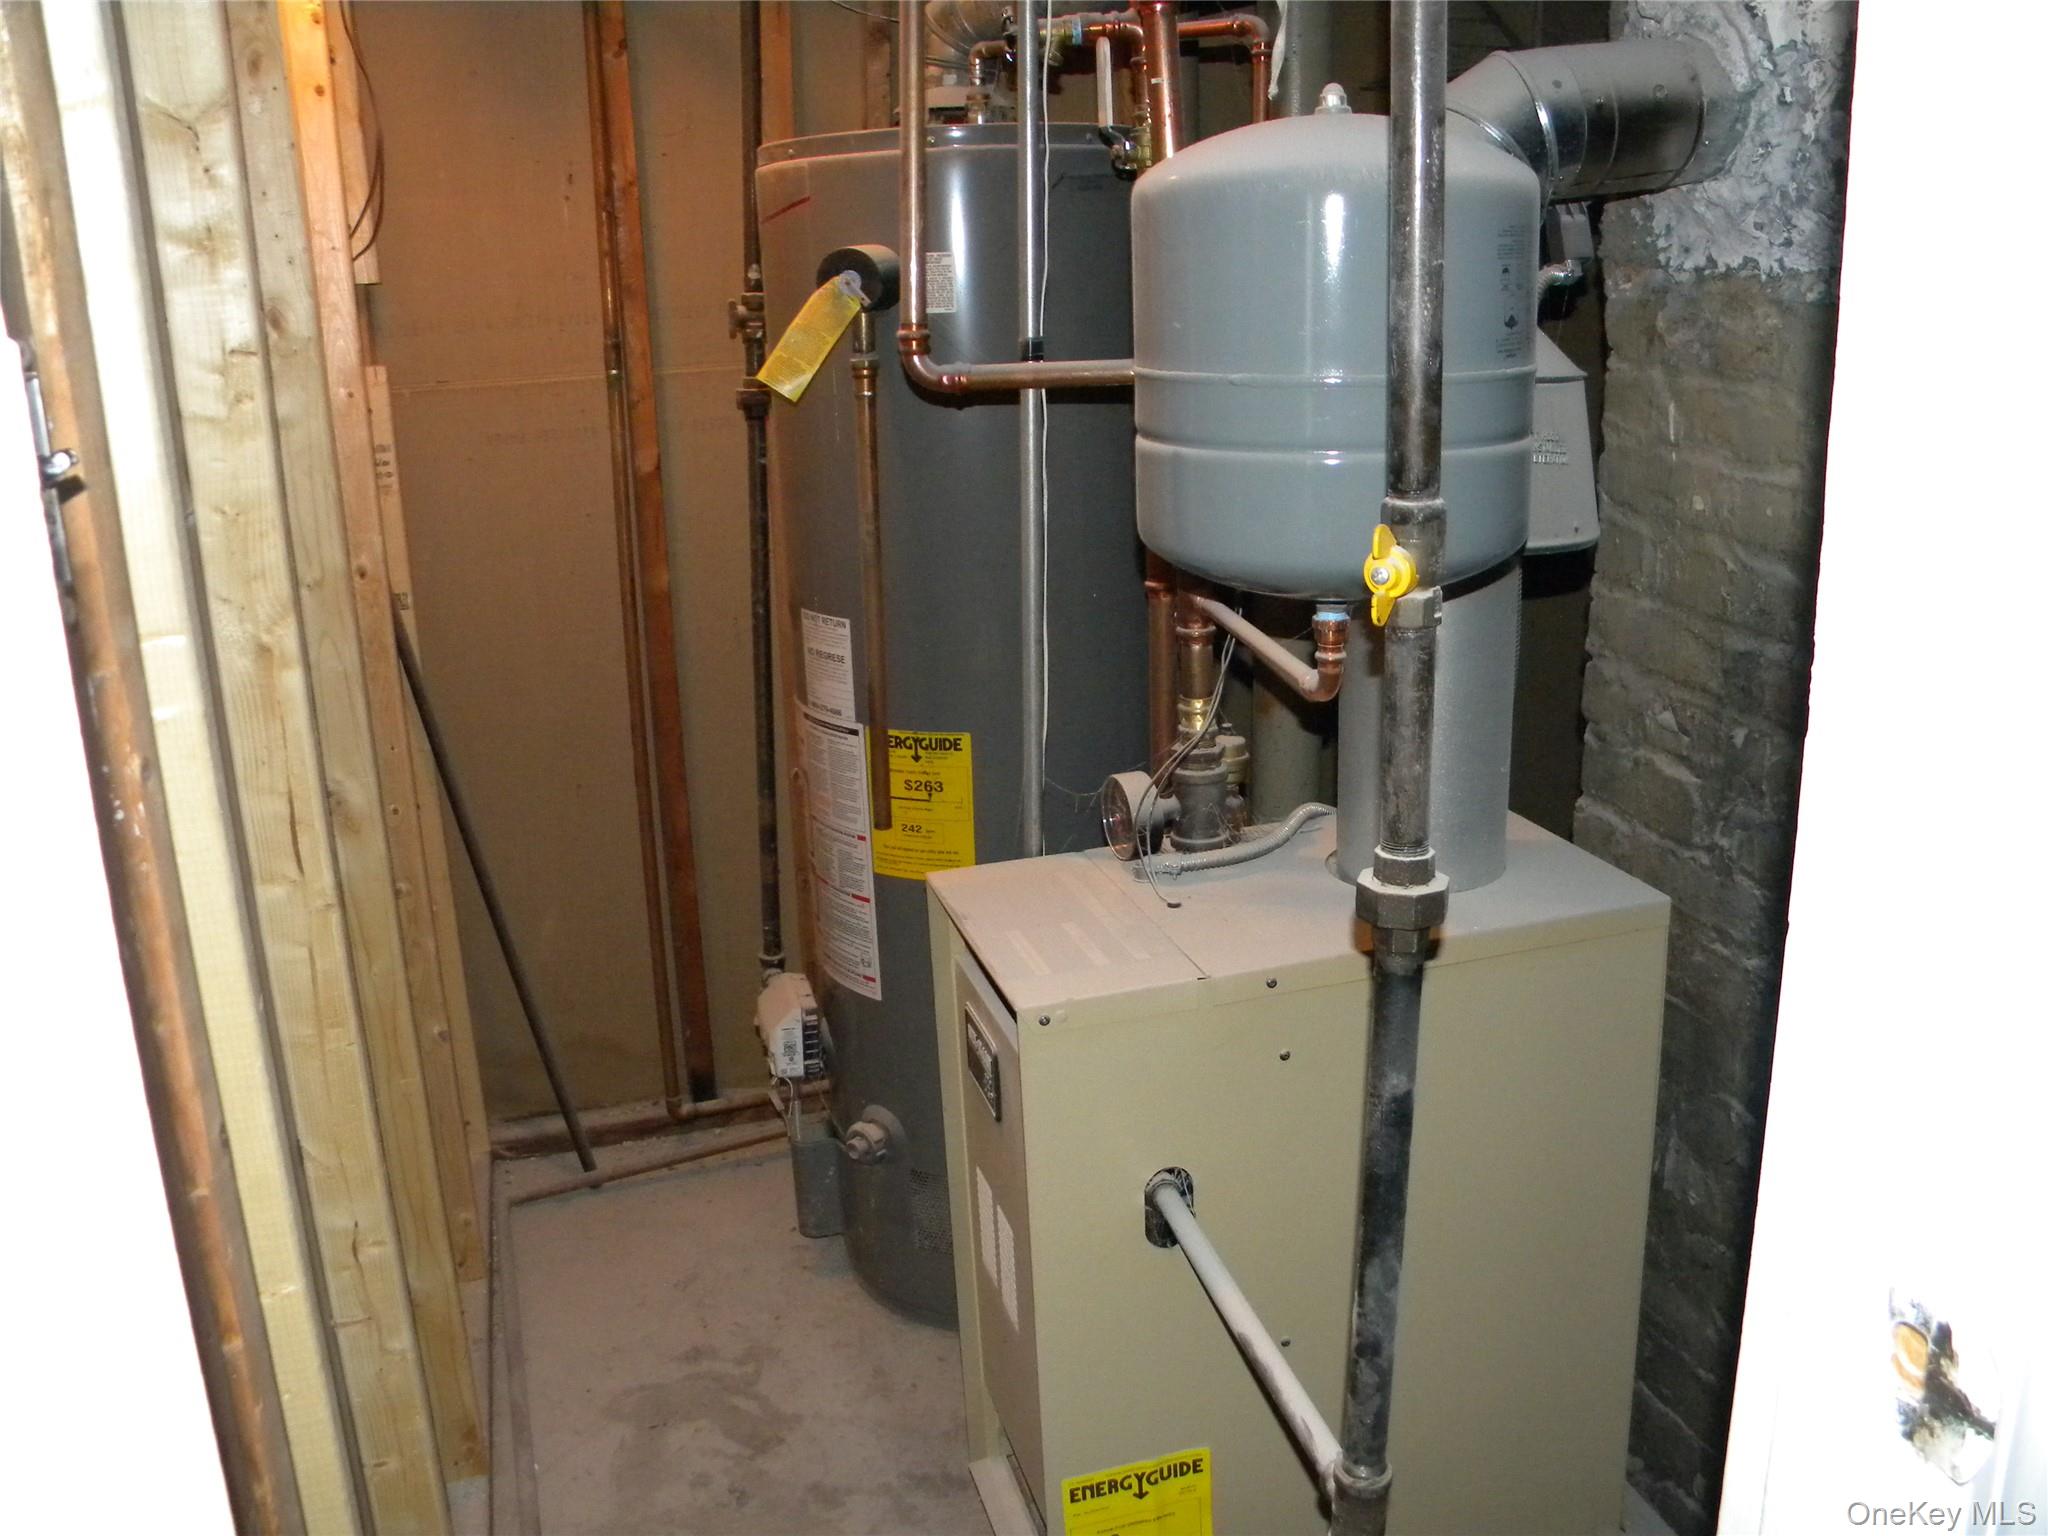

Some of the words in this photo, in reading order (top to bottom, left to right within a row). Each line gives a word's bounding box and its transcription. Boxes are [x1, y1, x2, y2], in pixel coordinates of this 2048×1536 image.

[888, 735, 963, 752] ERGYGUIDE
[901, 823, 922, 833] 242
[1069, 1458, 1204, 1504] ENERGYGUIDE
